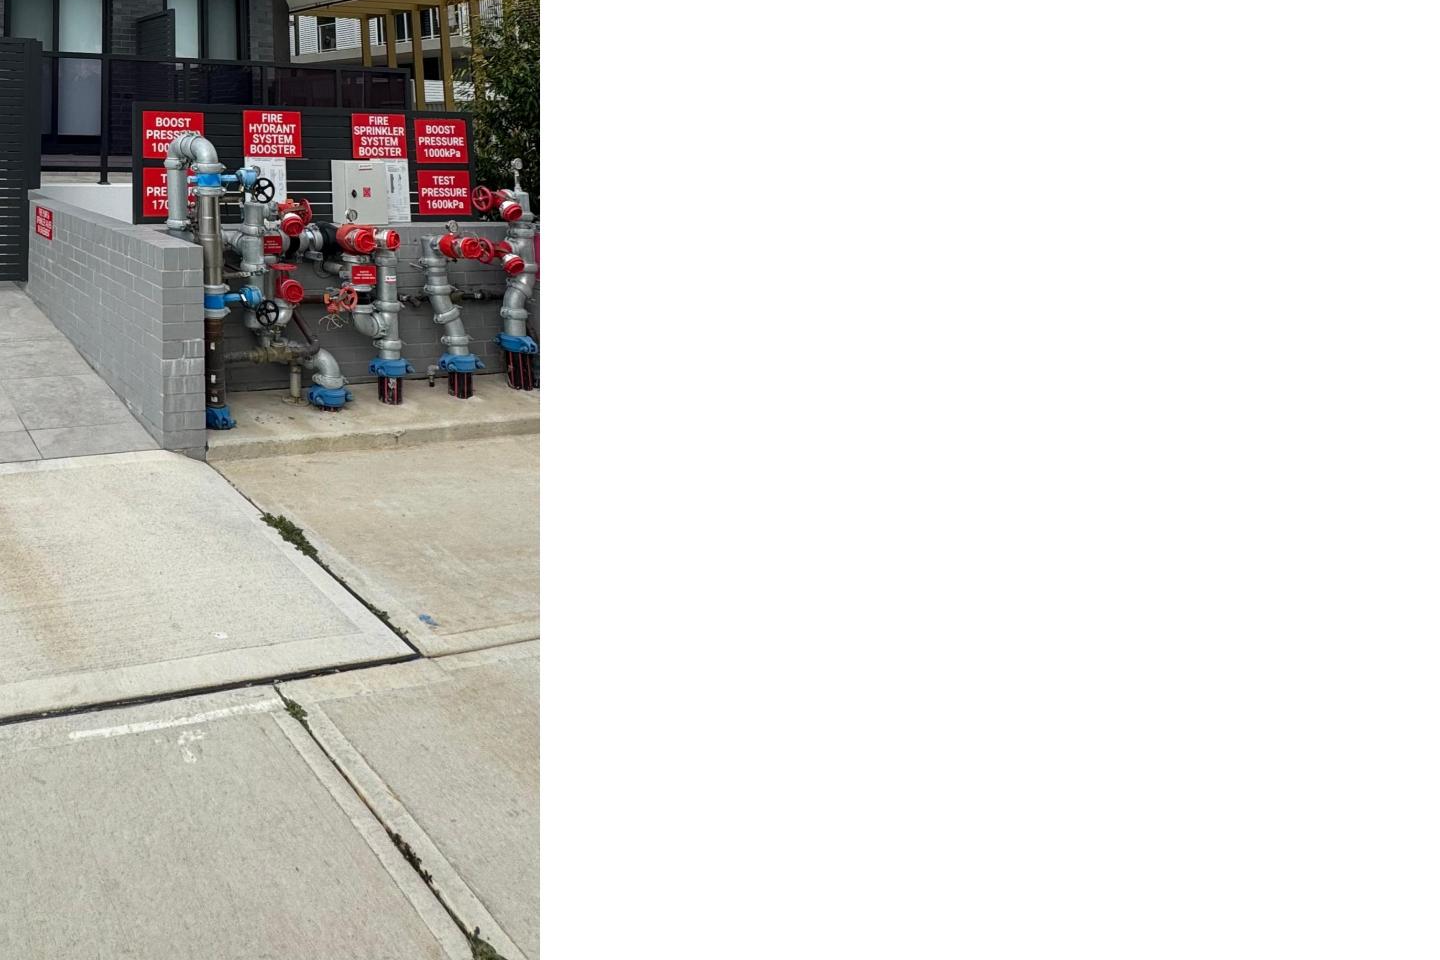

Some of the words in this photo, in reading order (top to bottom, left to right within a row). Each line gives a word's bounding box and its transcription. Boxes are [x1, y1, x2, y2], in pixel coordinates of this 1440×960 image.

[155, 117, 191, 128] BOOST
[262, 113, 283, 123] FIRE
[369, 116, 389, 126] FIRE
[249, 123, 296, 134] HYDRANT
[353, 126, 405, 136] SPRINKLER
[425, 125, 455, 134] BOOST
[146, 130, 201, 141] PRESS
[252, 134, 293, 144] SYSTEM
[360, 136, 398, 146] SYSTEM
[418, 136, 464, 146] PRESSURE
[250, 144, 296, 155] BOOSTER
[358, 146, 402, 156] BOOSTER
[423, 148, 461, 158] 1000kPa
[432, 175, 455, 185] TEST
[421, 187, 468, 197] PRESSURE
[426, 199, 464, 209] 1600kPa
